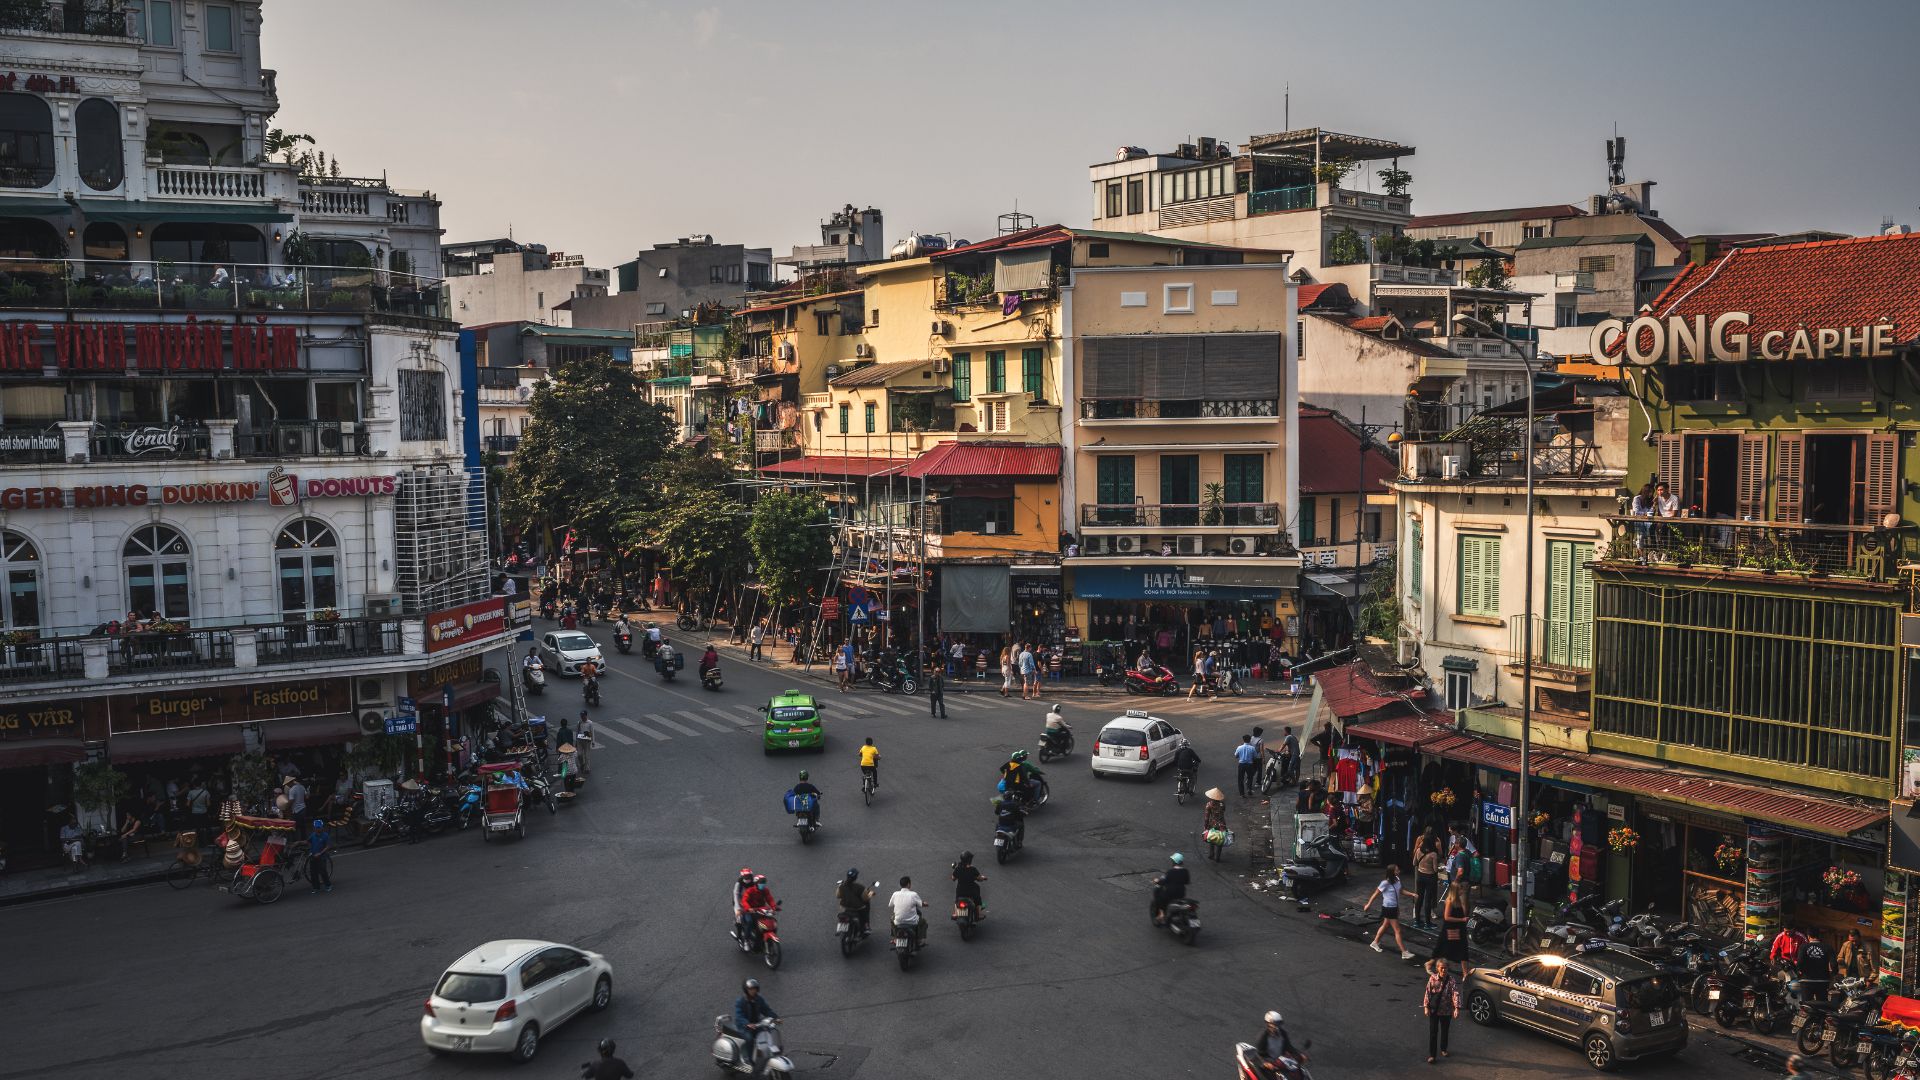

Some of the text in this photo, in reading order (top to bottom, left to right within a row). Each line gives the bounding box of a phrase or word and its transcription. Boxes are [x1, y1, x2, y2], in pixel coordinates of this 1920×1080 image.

[135, 313, 223, 369] MUÔN
[232, 312, 297, 369] NĂM
[12, 435, 31, 450] show
[31, 435, 38, 450] in
[38, 435, 60, 450] Hanoi
[2, 485, 148, 510] GER KING
[162, 476, 396, 505] DUNKIN' DONUTS
[149, 696, 206, 717] Burger
[253, 687, 319, 707] Fastfood
[1486, 812, 1499, 822] CẦU
